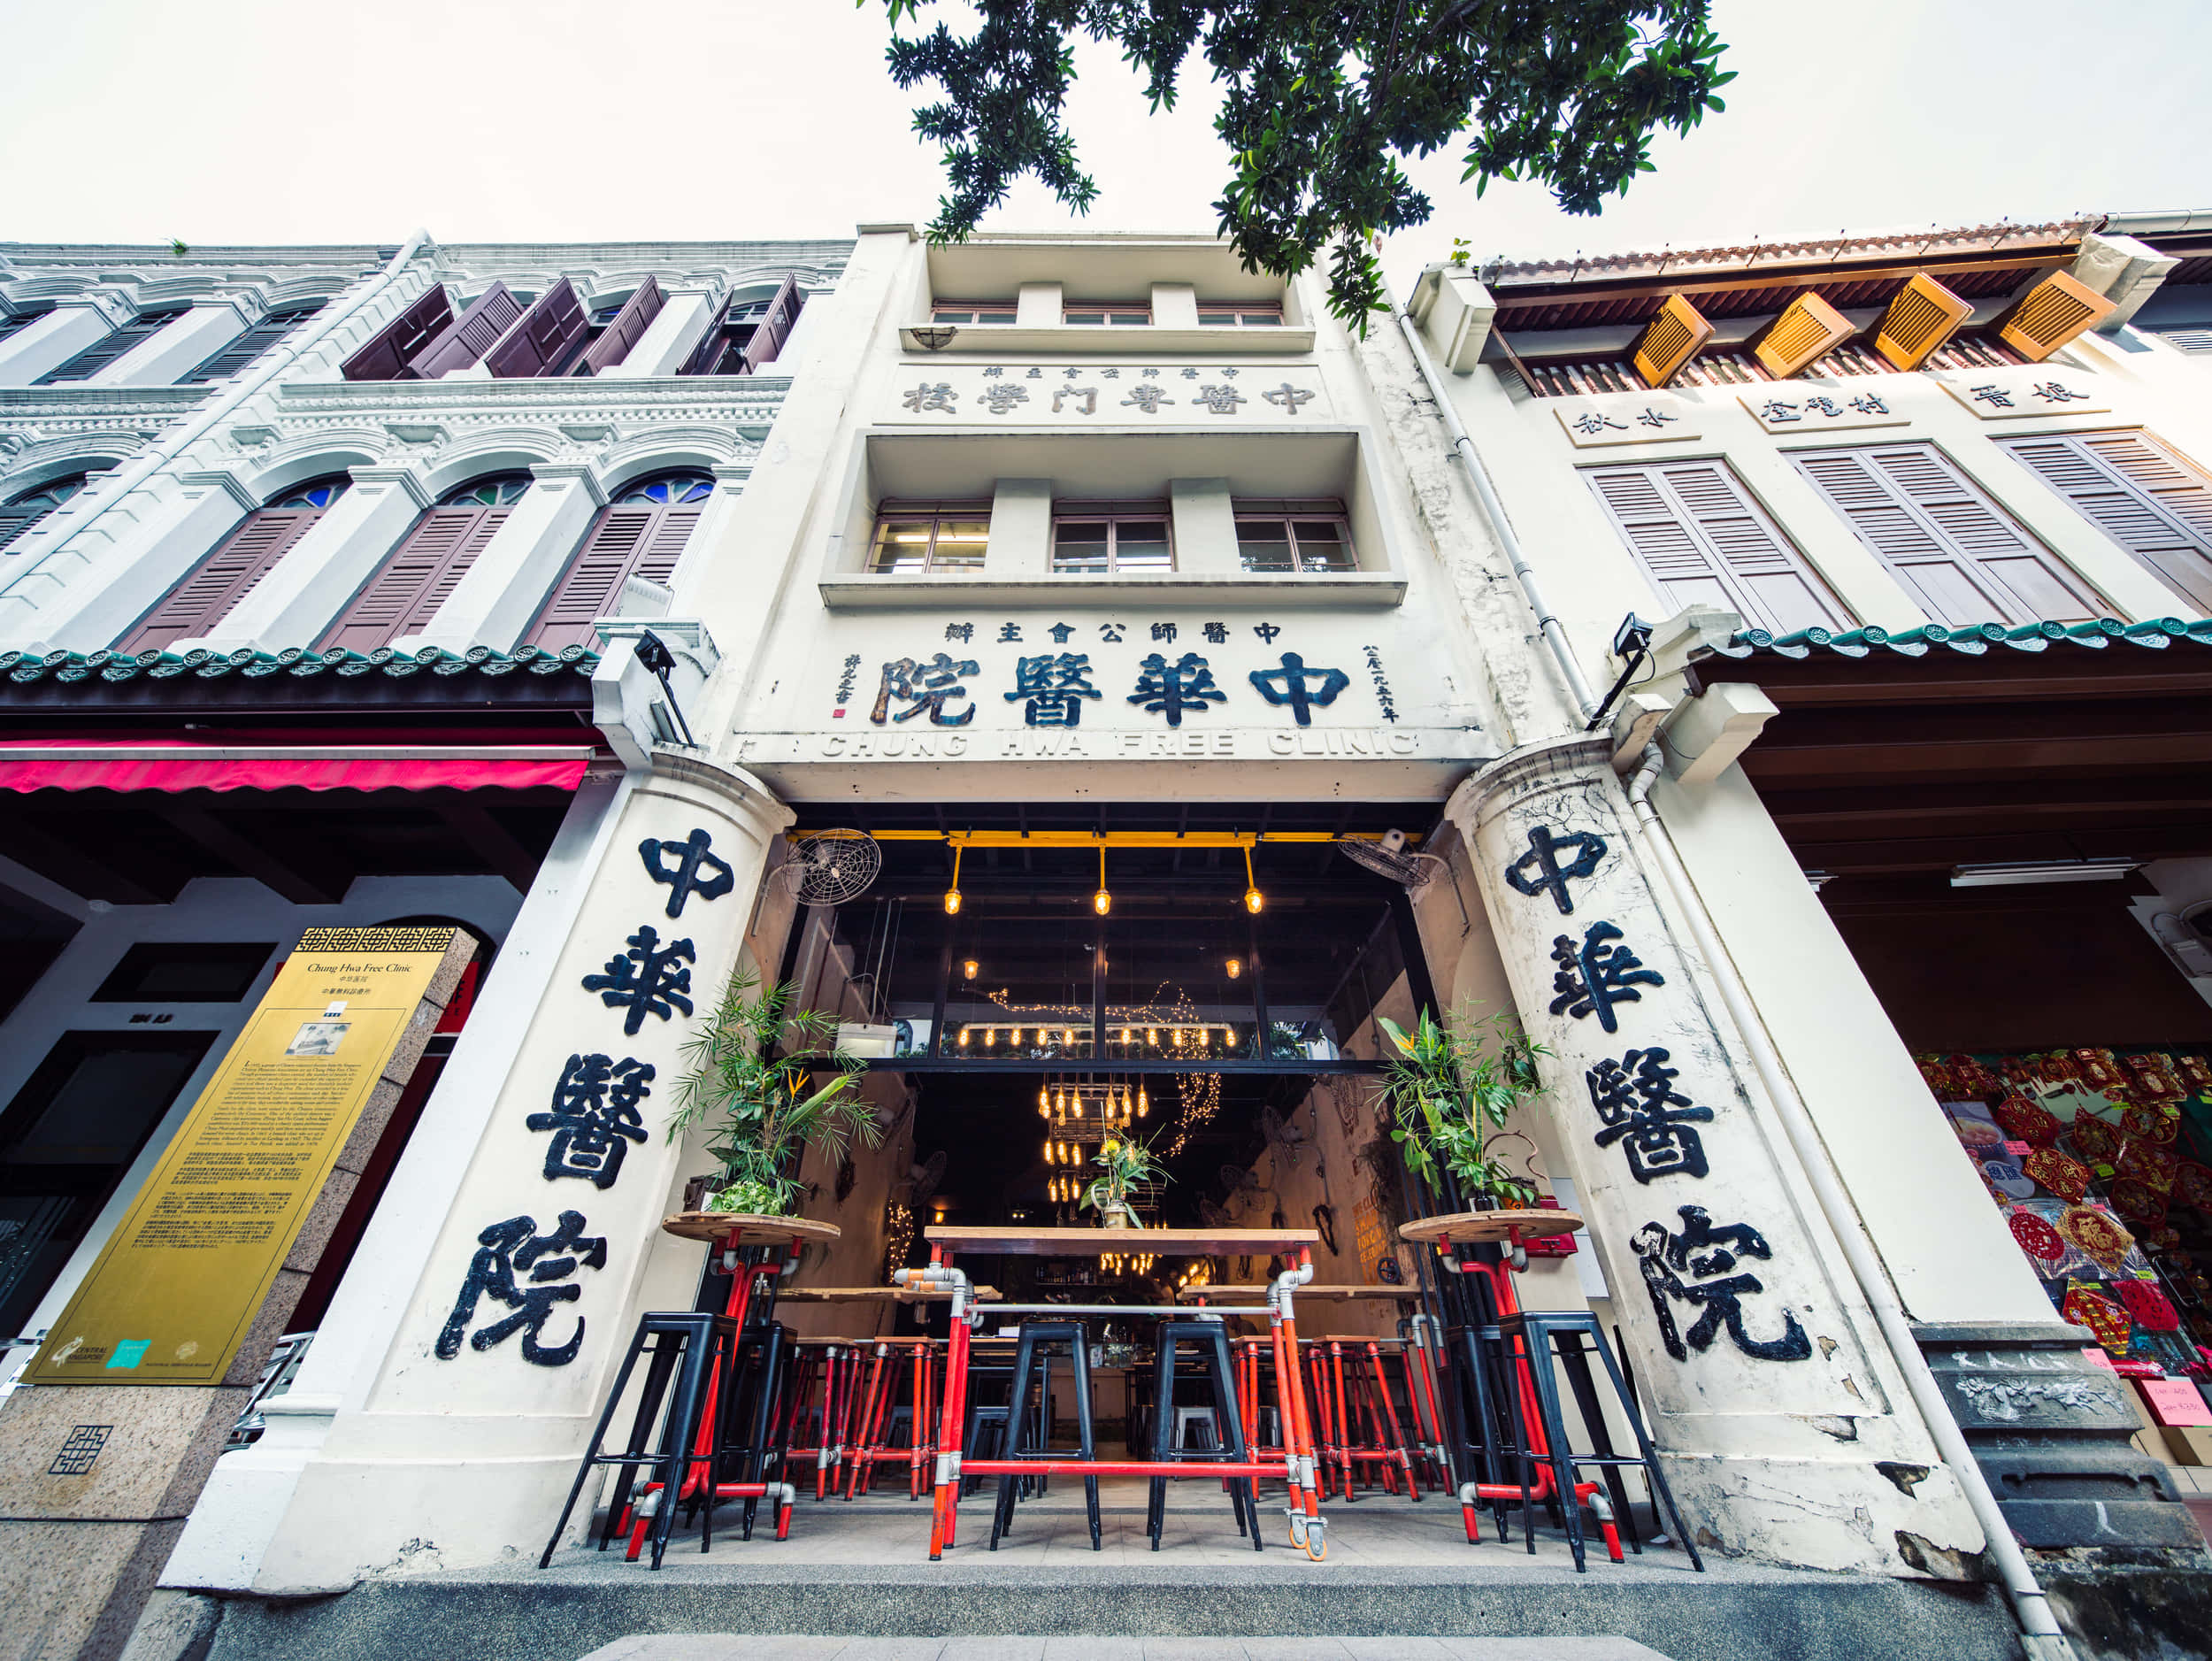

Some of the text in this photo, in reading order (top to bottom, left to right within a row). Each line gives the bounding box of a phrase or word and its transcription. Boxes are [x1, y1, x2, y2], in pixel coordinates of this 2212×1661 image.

[945, 622, 1281, 644] 中醫師公會主辦
[870, 652, 1350, 727] 中華醫院
[821, 731, 1419, 757] CHUNG HWA FREE CLINIC
[307, 964, 411, 973] Chung Hwa Free Clinic
[434, 827, 735, 1367] 中華醫院
[1505, 825, 1813, 1363] 中華醫院
